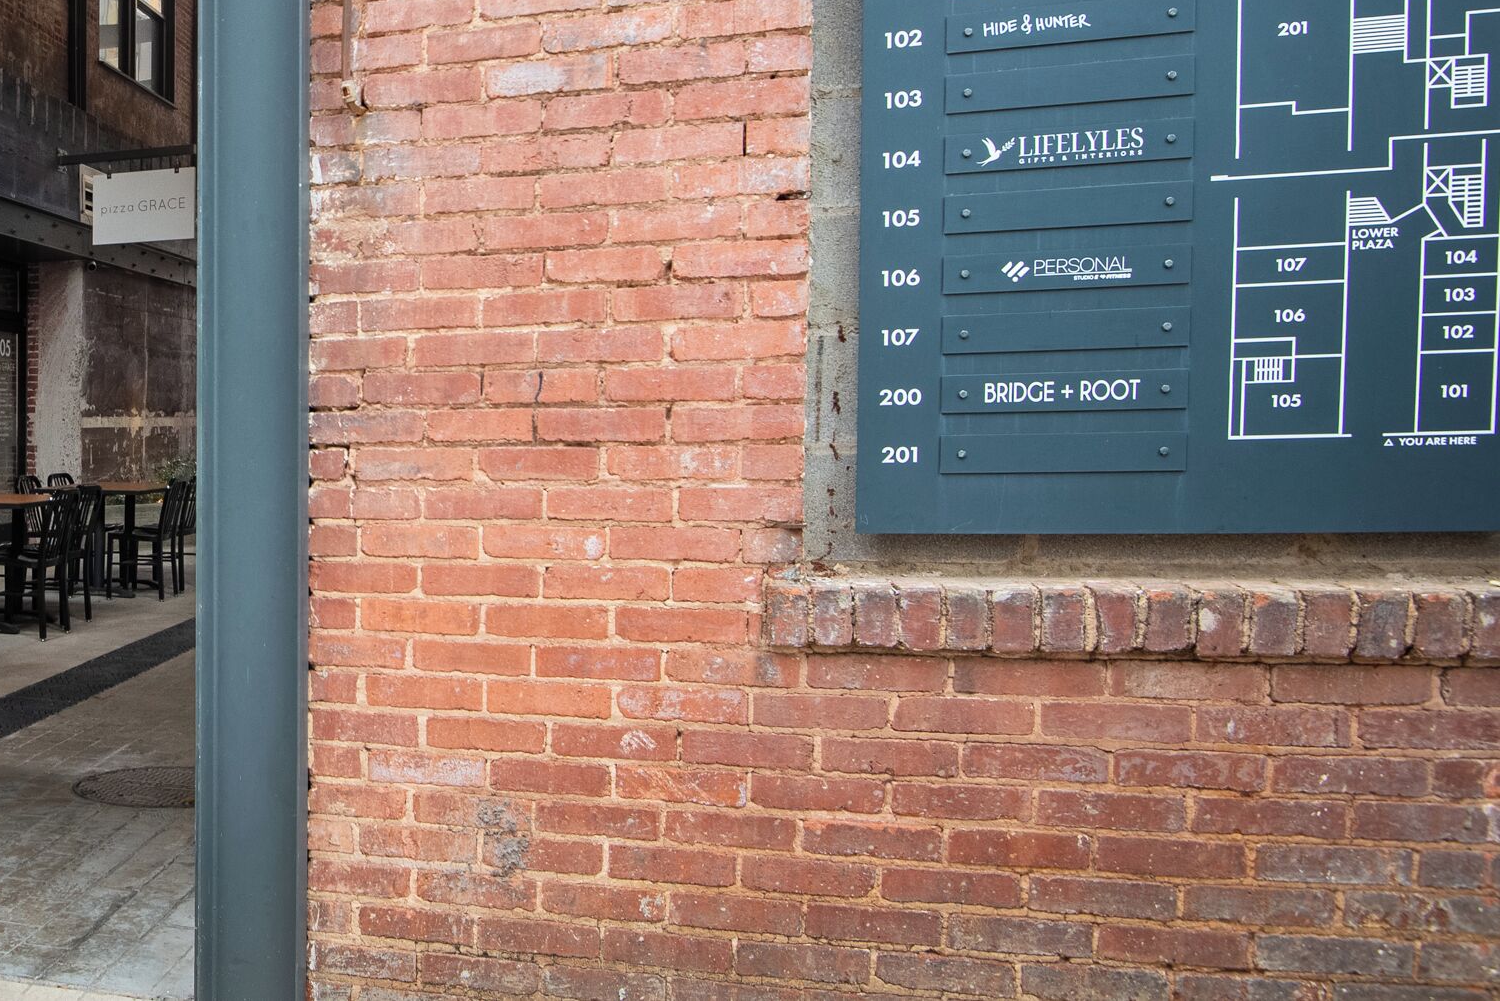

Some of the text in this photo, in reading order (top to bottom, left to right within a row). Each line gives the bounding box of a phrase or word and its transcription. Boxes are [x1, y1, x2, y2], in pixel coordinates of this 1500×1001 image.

[884, 13, 1092, 49] 102 HIDE & HUNTER
[1277, 20, 1308, 37] 201
[884, 89, 923, 110] 103
[882, 126, 1144, 169] 104 LIFELYLES
[1018, 156, 1055, 165] GIFTS
[1075, 149, 1143, 161] INTERIORS
[100, 196, 187, 217] pizza GRACE
[882, 208, 921, 228] 105
[1351, 227, 1399, 239] LOWER
[1351, 239, 1394, 251] PLAZA
[1275, 257, 1307, 272] 107
[1444, 249, 1478, 265] 104
[881, 256, 1132, 287] 106 PERSONAL
[1443, 287, 1476, 302] 103
[1274, 308, 1306, 323] 106
[881, 328, 920, 347] 107
[1442, 324, 1474, 340] 102
[879, 388, 922, 406] 200
[984, 381, 1055, 404] BRIDGE
[1079, 378, 1141, 401] ROOT
[1440, 383, 1469, 399] 101
[1271, 393, 1302, 408] 105
[1399, 436, 1477, 447] YOU ARE HERE
[881, 446, 919, 464] 201
